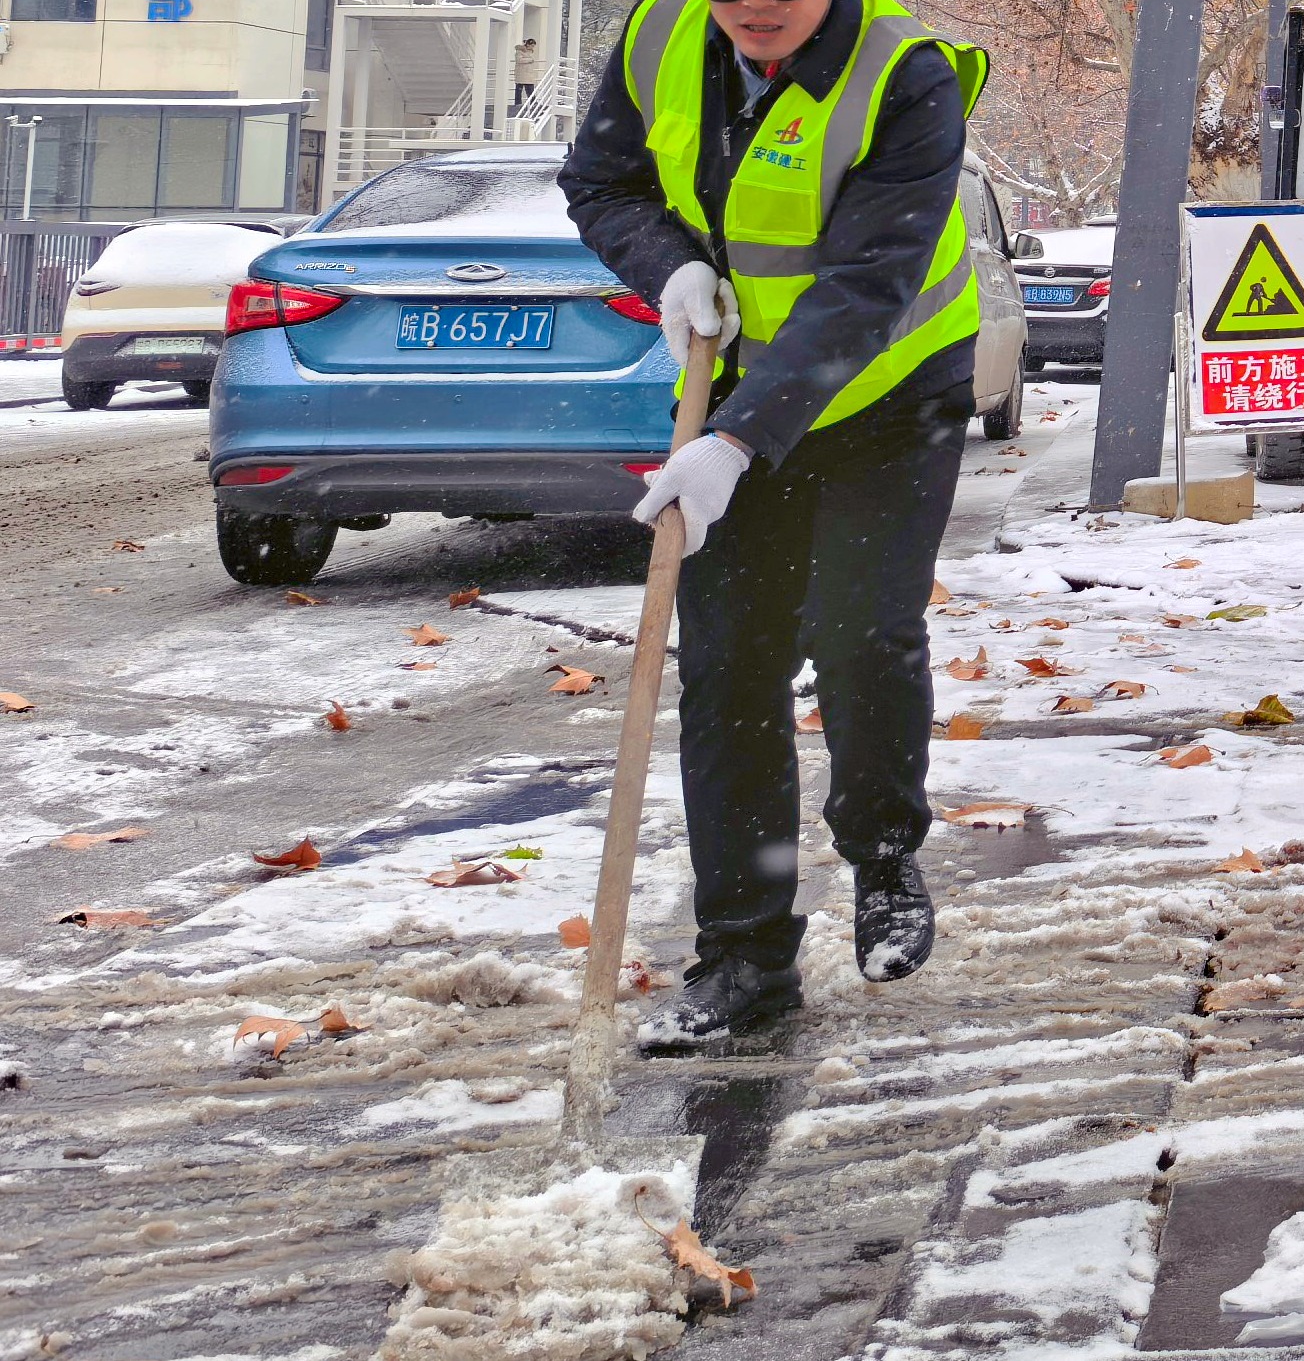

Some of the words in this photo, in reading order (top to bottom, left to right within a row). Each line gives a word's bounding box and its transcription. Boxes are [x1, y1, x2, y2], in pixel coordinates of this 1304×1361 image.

[752, 146, 807, 171] 安徽建工
[400, 311, 549, 342] 皖B·657J7
